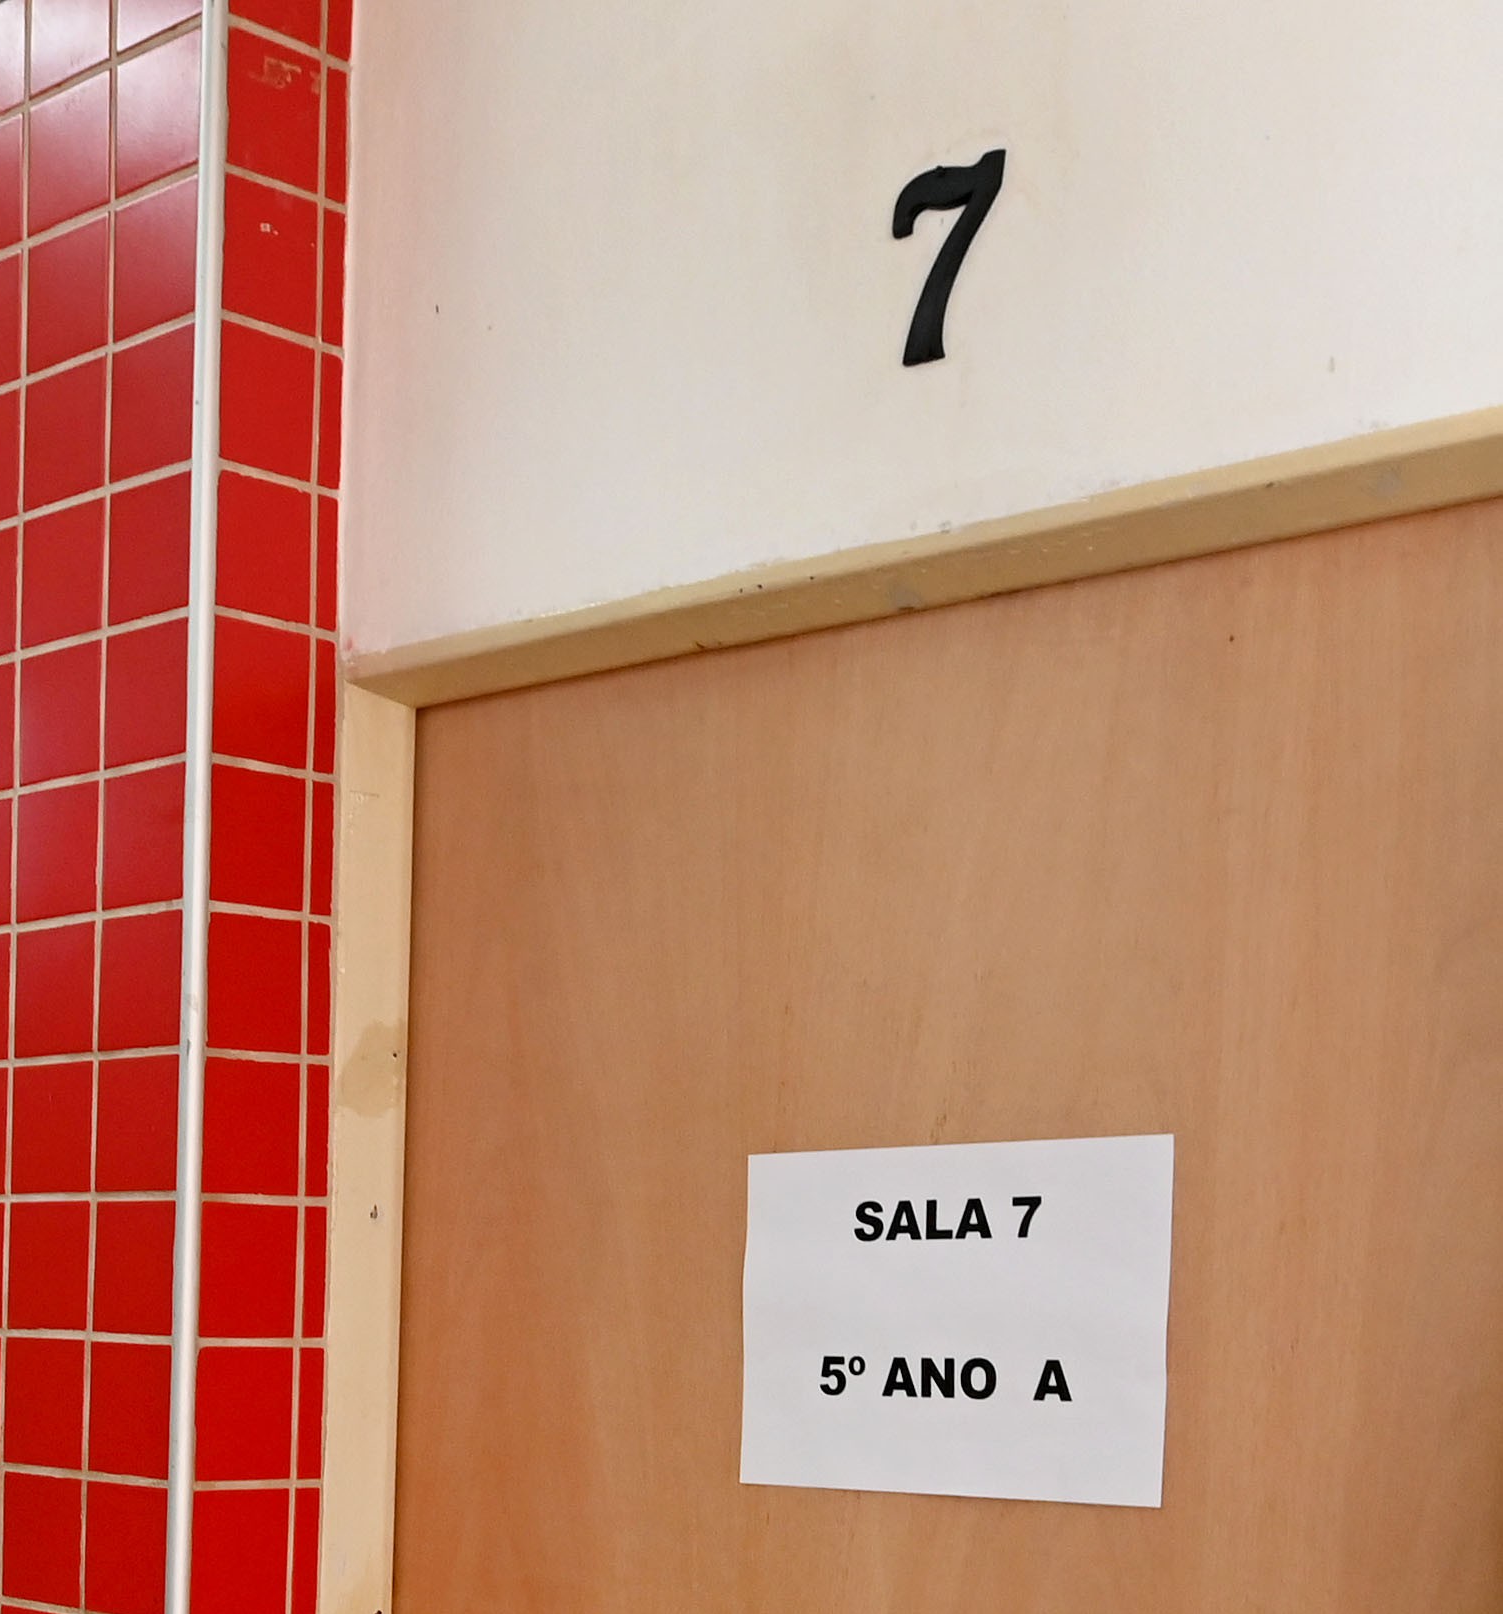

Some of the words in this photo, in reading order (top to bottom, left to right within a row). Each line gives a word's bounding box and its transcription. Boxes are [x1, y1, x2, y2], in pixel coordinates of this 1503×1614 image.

[892, 148, 1006, 367] 7
[854, 1198, 992, 1242] SALA
[1011, 1195, 1043, 1239] 7
[819, 1355, 866, 1397] 5º
[882, 1357, 997, 1400] ANO
[1033, 1359, 1073, 1402] A
